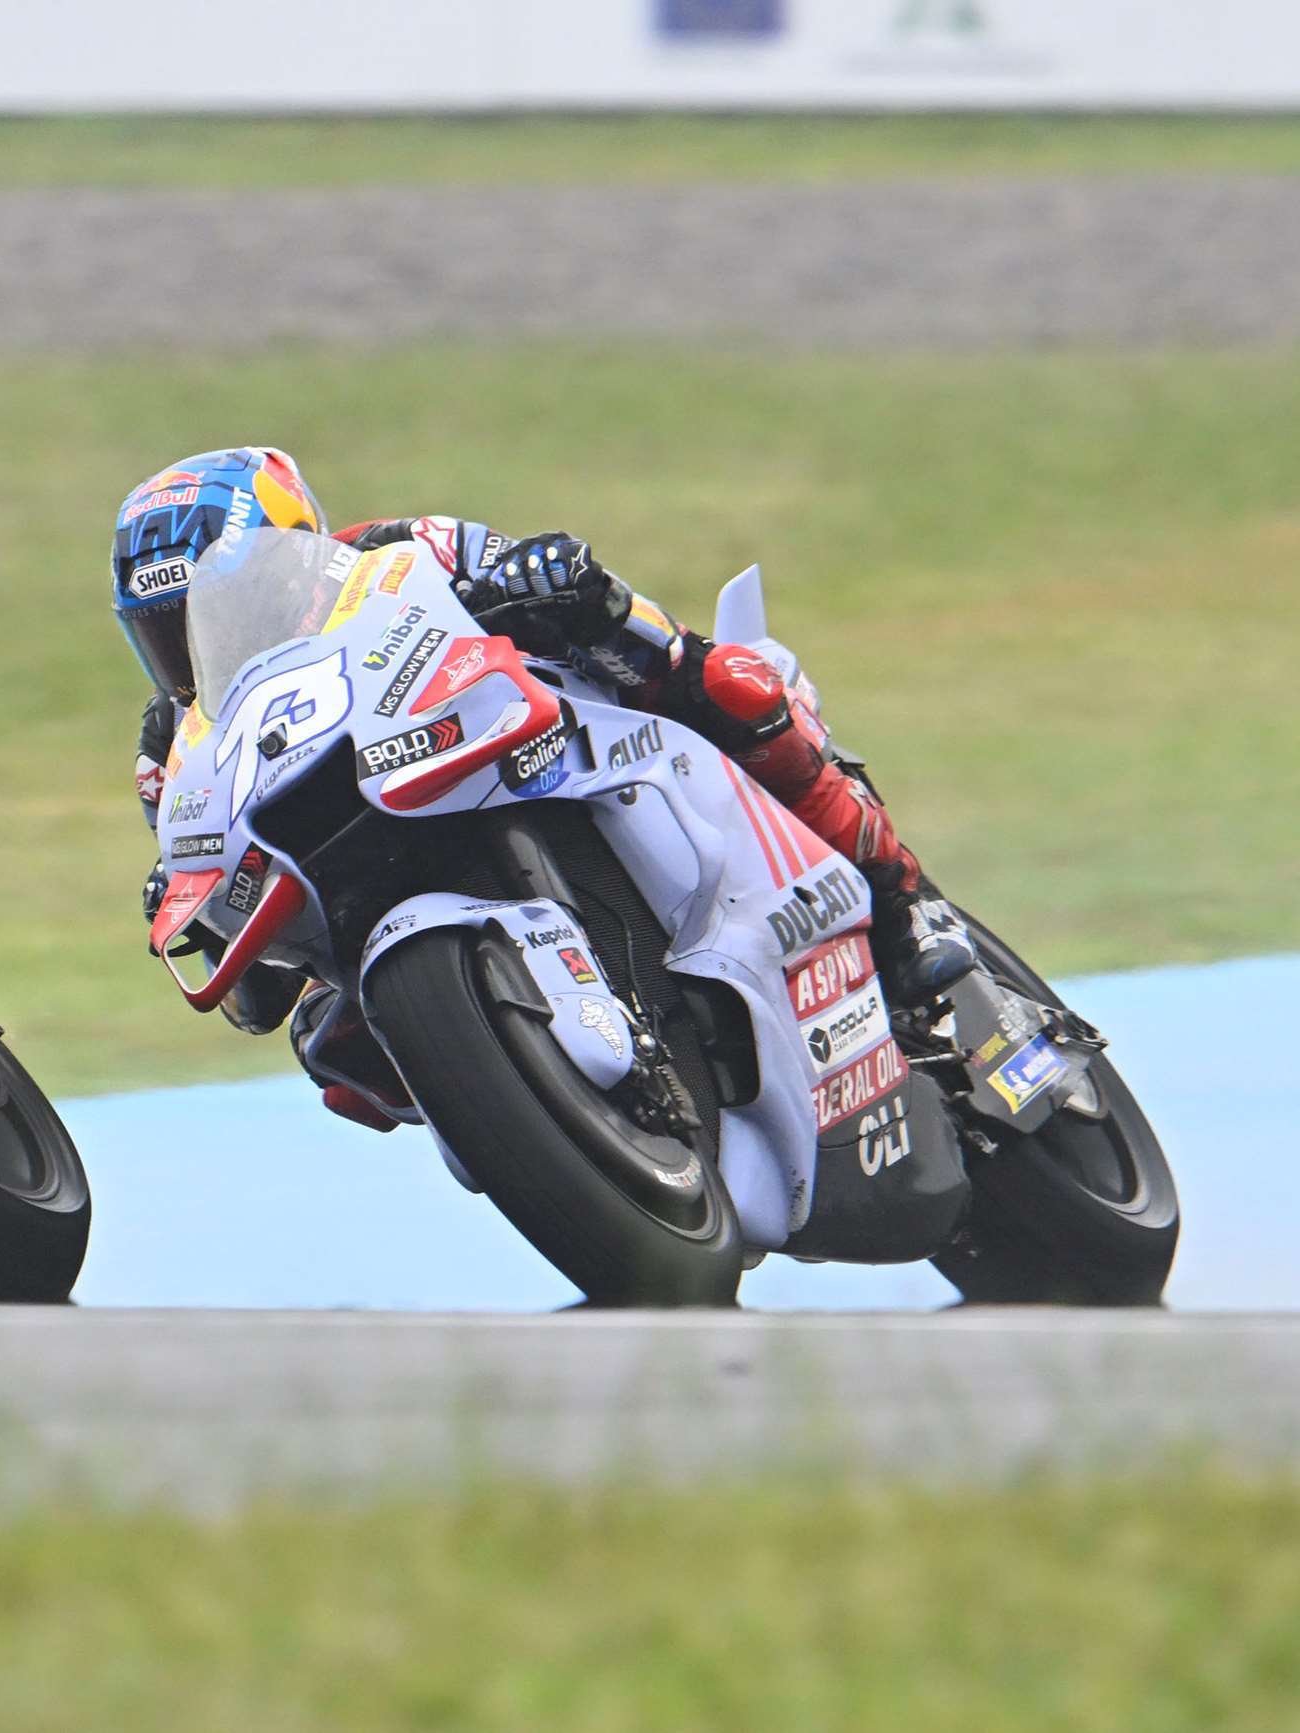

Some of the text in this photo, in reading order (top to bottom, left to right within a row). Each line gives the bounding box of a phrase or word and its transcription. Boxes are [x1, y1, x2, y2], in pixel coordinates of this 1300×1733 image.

[158, 487, 200, 506] Bull
[481, 536, 501, 568] BOLD
[137, 563, 188, 592] SHOEI
[361, 604, 428, 671] Unibat
[378, 630, 444, 715] MS GLOW MEN
[362, 730, 430, 768] BOLD
[371, 748, 434, 774] RIDERS
[229, 872, 253, 910] BOLD
[766, 867, 860, 956] DUCATI
[876, 1039, 901, 1090] OIL
